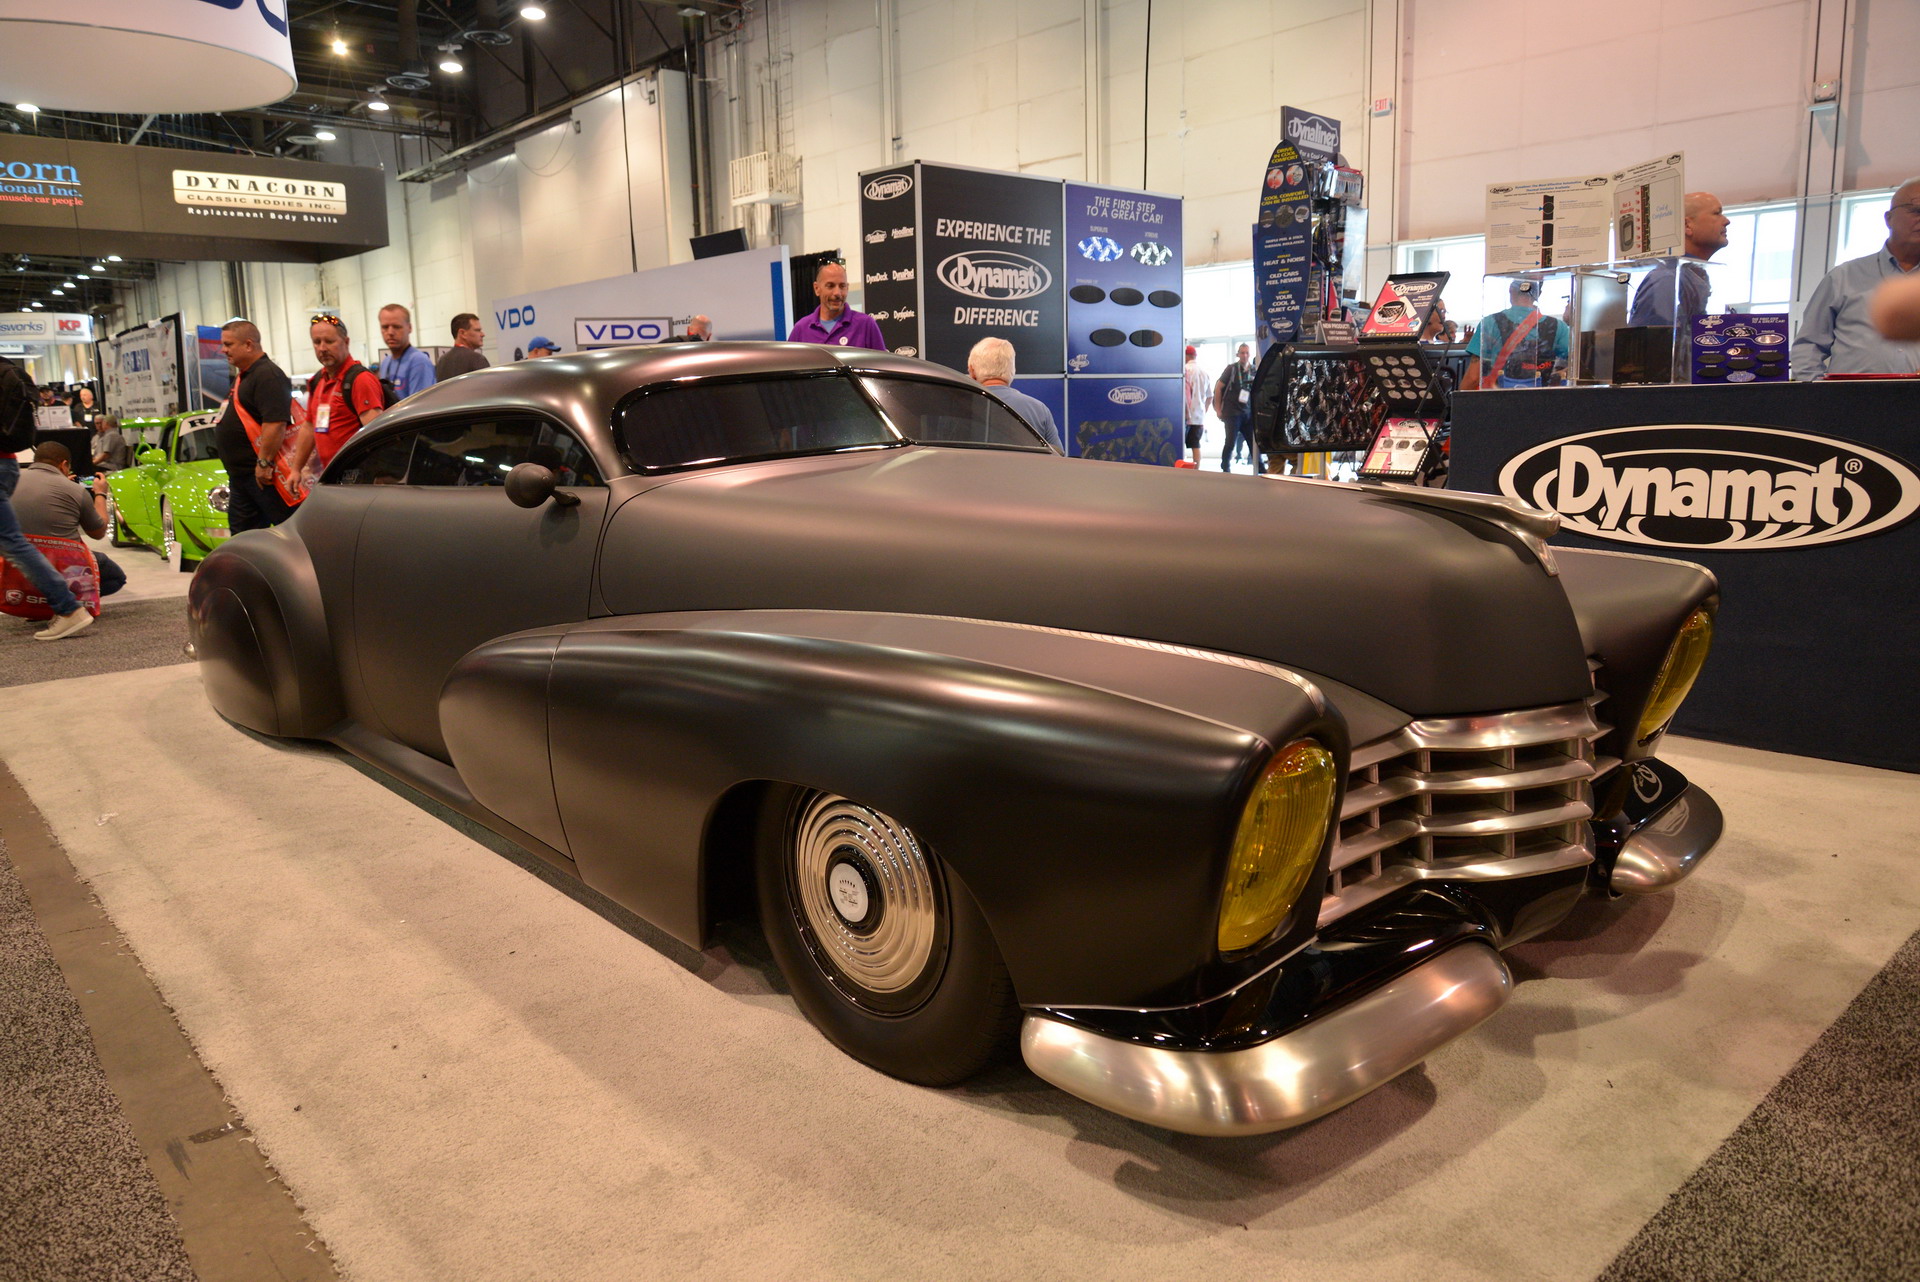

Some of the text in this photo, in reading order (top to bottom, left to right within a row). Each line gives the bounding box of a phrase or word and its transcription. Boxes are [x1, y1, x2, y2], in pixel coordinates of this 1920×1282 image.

[1375, 98, 1388, 111] EXIT
[1293, 117, 1337, 147] Dynaliner
[1271, 154, 1299, 164] COMFORT
[49, 184, 83, 198] Inc.
[186, 176, 335, 198] DYNACORN
[1280, 190, 1306, 199] COMFORT
[35, 196, 50, 204] car
[52, 196, 84, 206] people
[187, 194, 336, 211] CLASSIC BODIES INC.
[1095, 196, 1156, 213] THE FIRST STEP
[188, 207, 338, 224] Replacement Body Shells
[1086, 205, 1164, 224] TO A GREAT CAR!
[936, 218, 1051, 246] EXPERIENCE THE
[957, 256, 1035, 293] Dynamat
[1280, 276, 1302, 284] NEWER
[1283, 270, 1299, 278] CARS
[58, 319, 81, 331] KP
[495, 305, 535, 330] VDO
[954, 306, 1039, 327] DIFFERENCE
[585, 324, 661, 340] VDO
